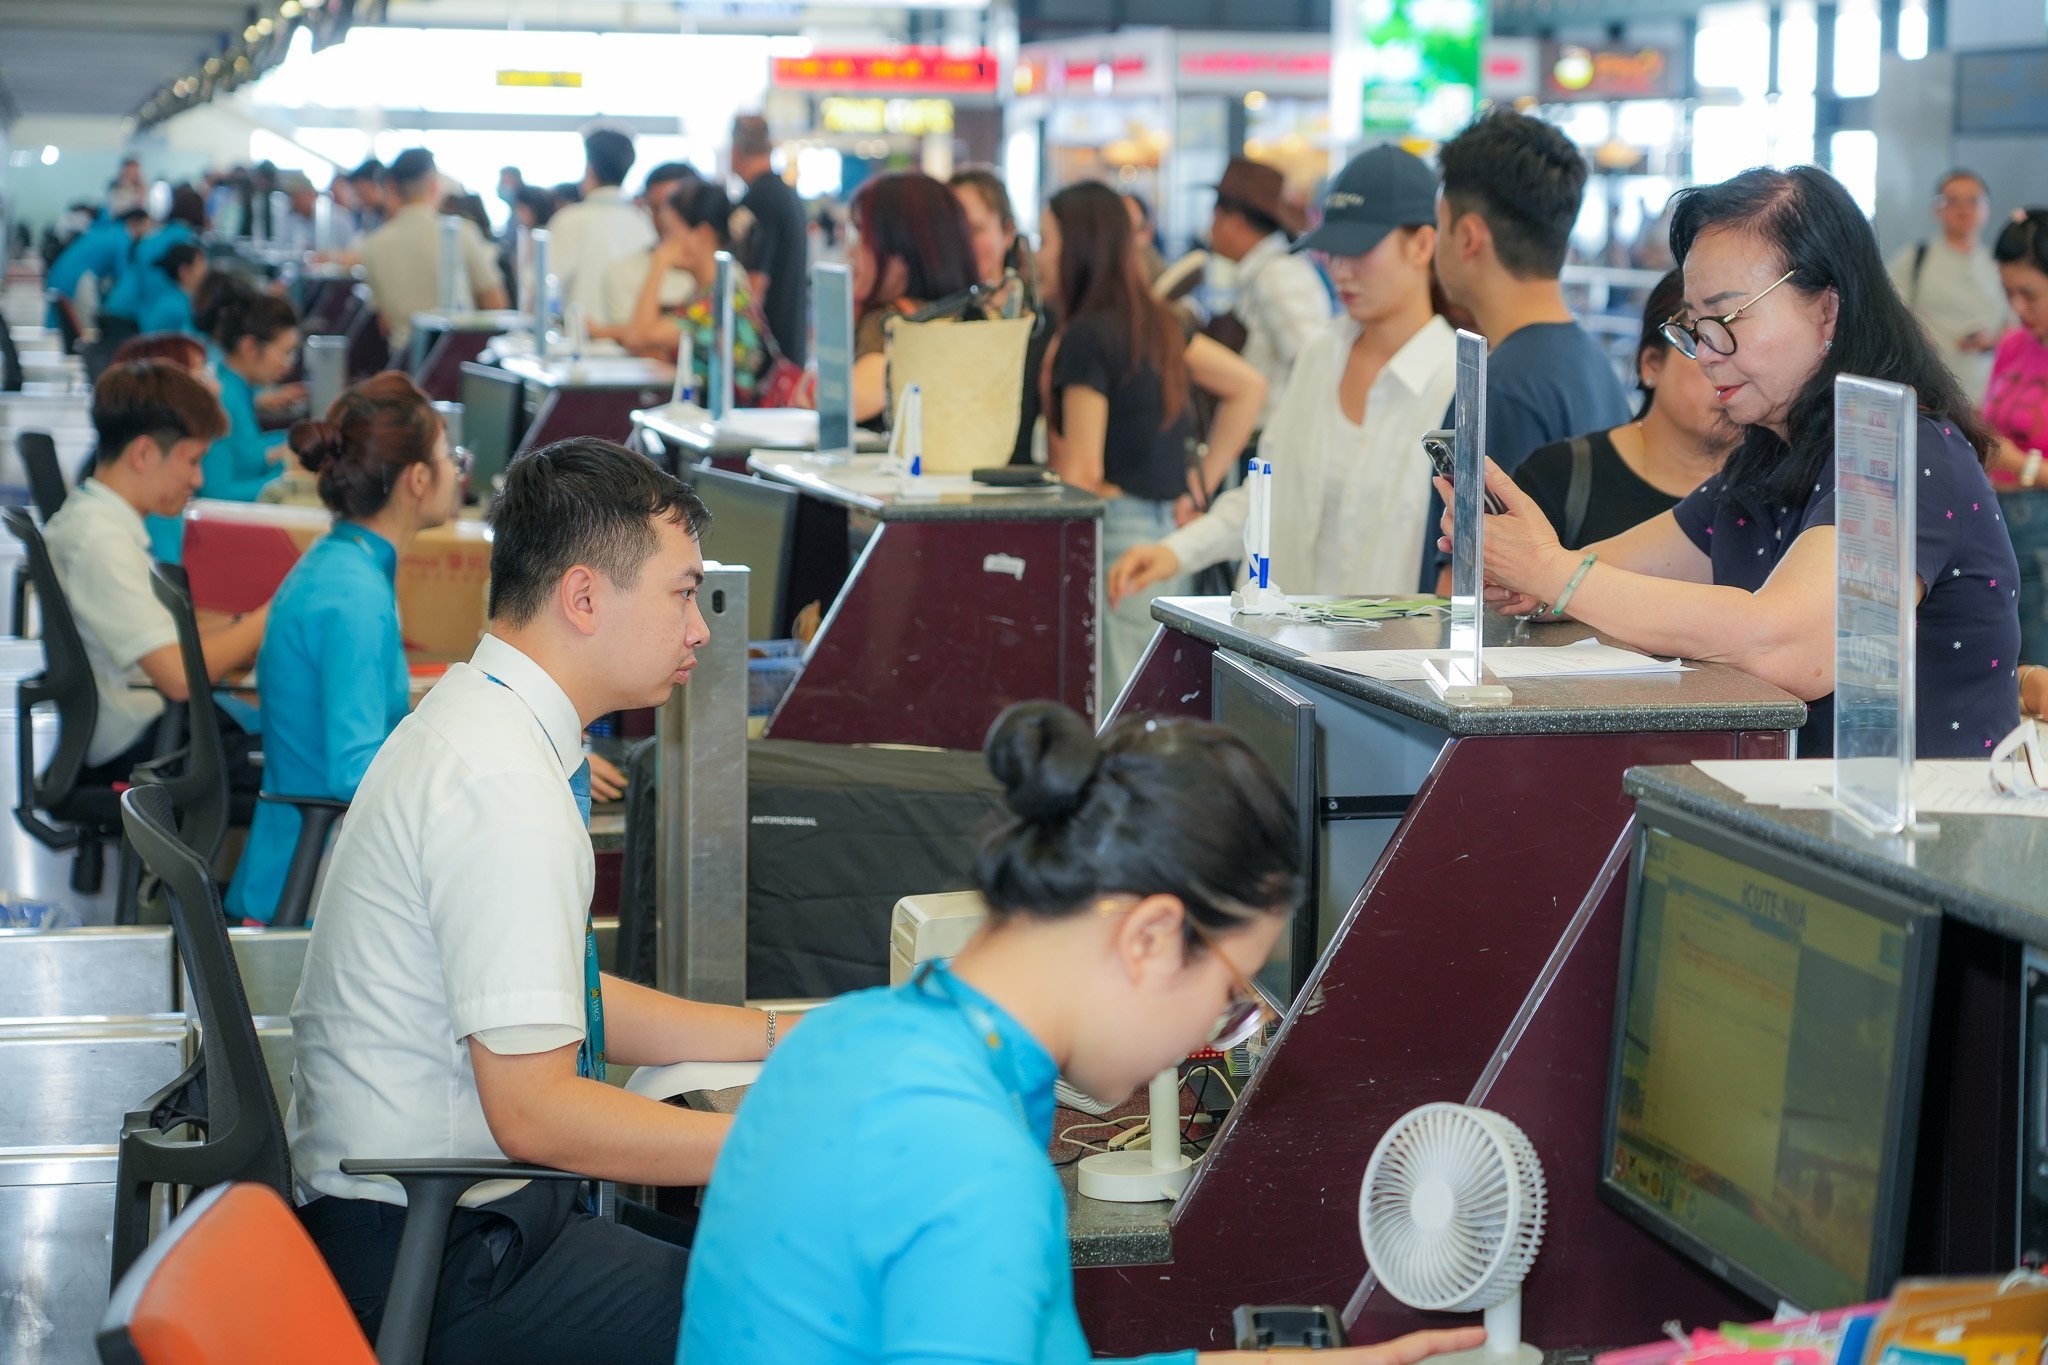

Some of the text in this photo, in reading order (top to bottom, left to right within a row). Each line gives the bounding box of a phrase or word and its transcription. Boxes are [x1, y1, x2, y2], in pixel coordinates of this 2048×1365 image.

[750, 815, 818, 827] ANTIMICROBIAL
[586, 936, 594, 958] VIAGS
[592, 999, 601, 1023] VIAGS
